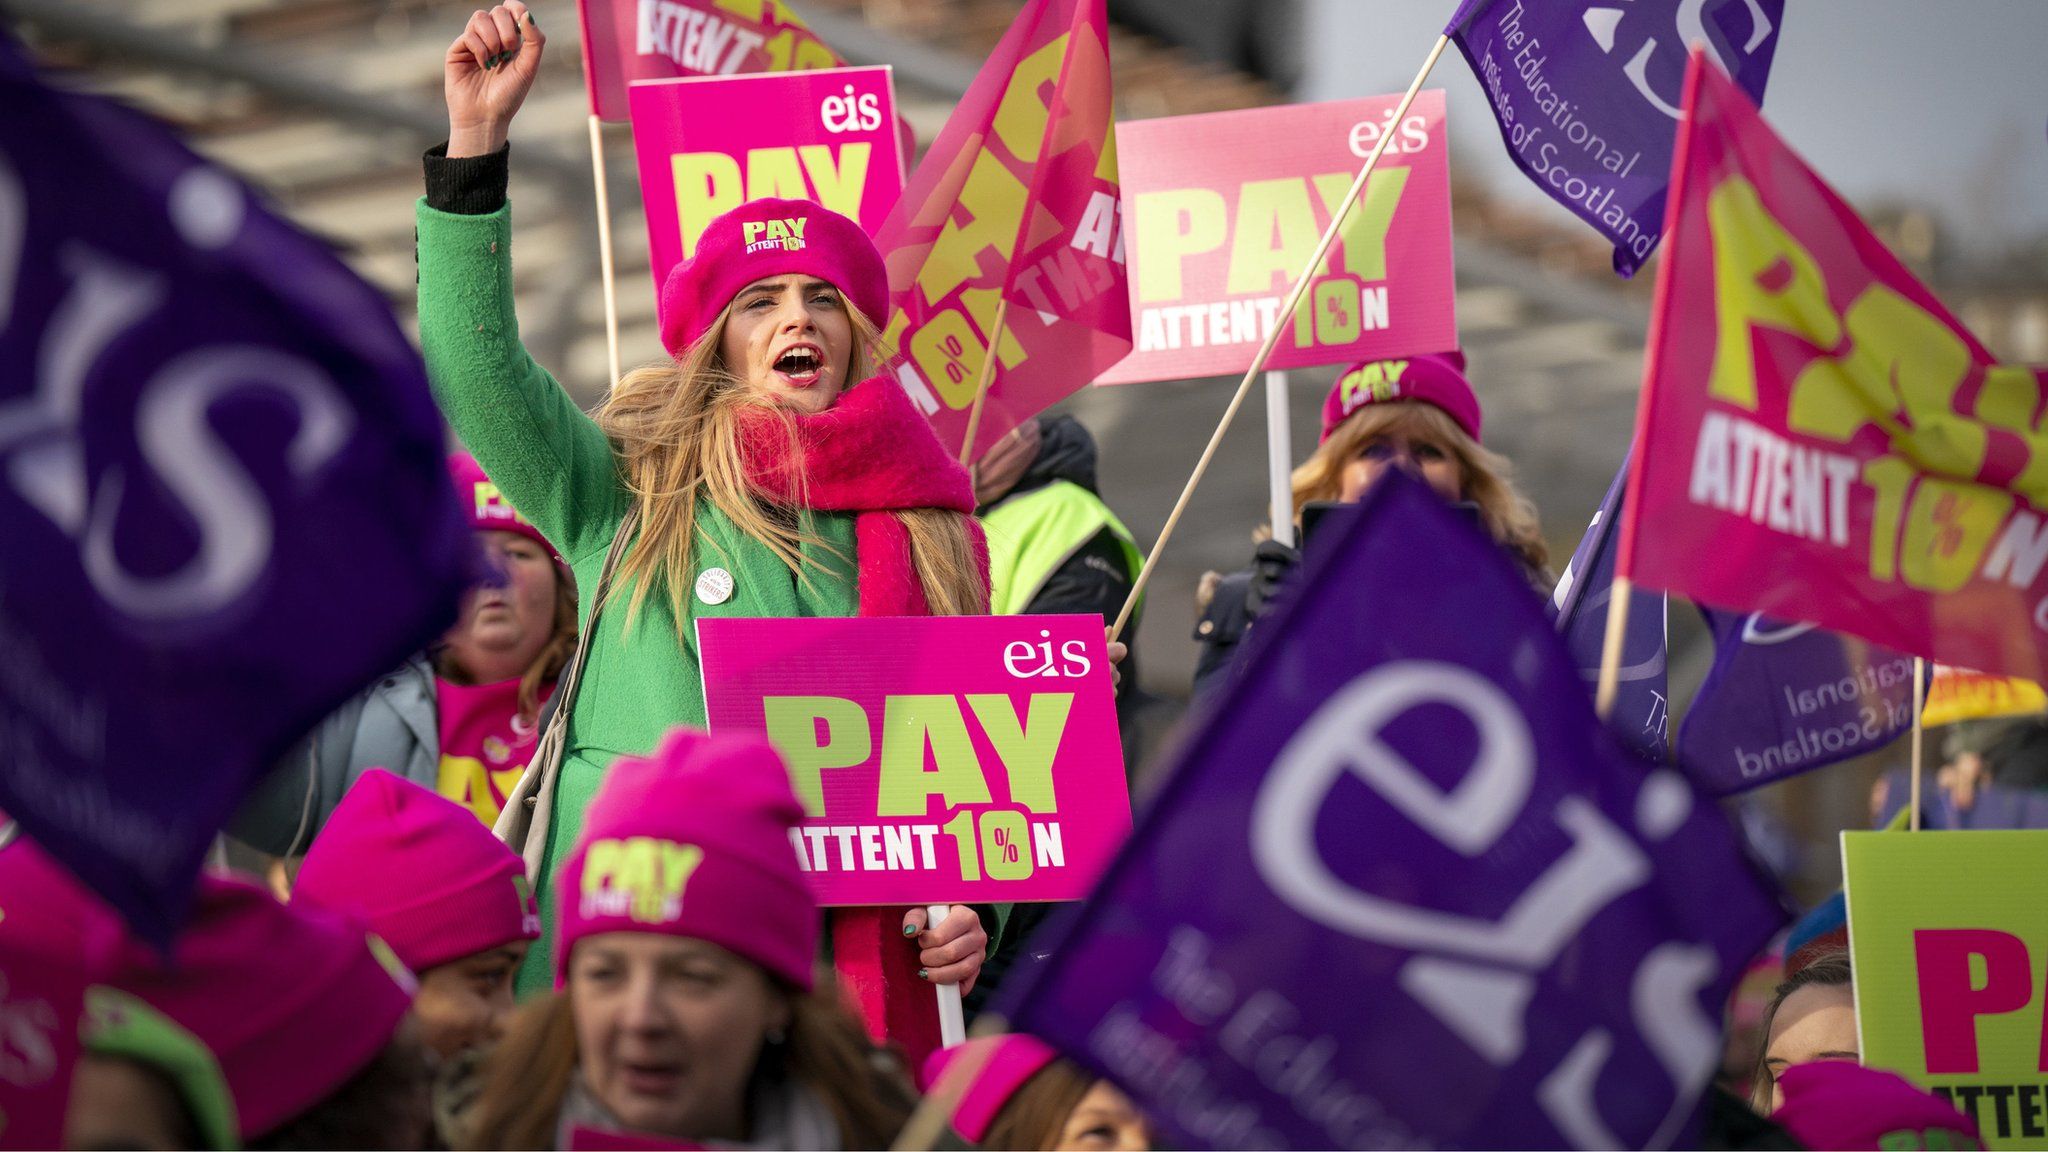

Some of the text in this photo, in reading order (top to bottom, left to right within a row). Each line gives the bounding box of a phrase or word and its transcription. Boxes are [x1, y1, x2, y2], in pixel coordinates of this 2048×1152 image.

[821, 84, 882, 133] eis
[1498, 0, 1640, 179] The Educational
[1348, 108, 1429, 158] eis
[1511, 122, 1542, 154] of
[1531, 142, 1658, 259] Scotland
[742, 217, 808, 246] PAY
[1135, 166, 1411, 303] PAY
[1341, 360, 1409, 405] PAY
[1003, 630, 1091, 679] eis
[763, 692, 1075, 817] PAY
[580, 836, 705, 895] PAY
